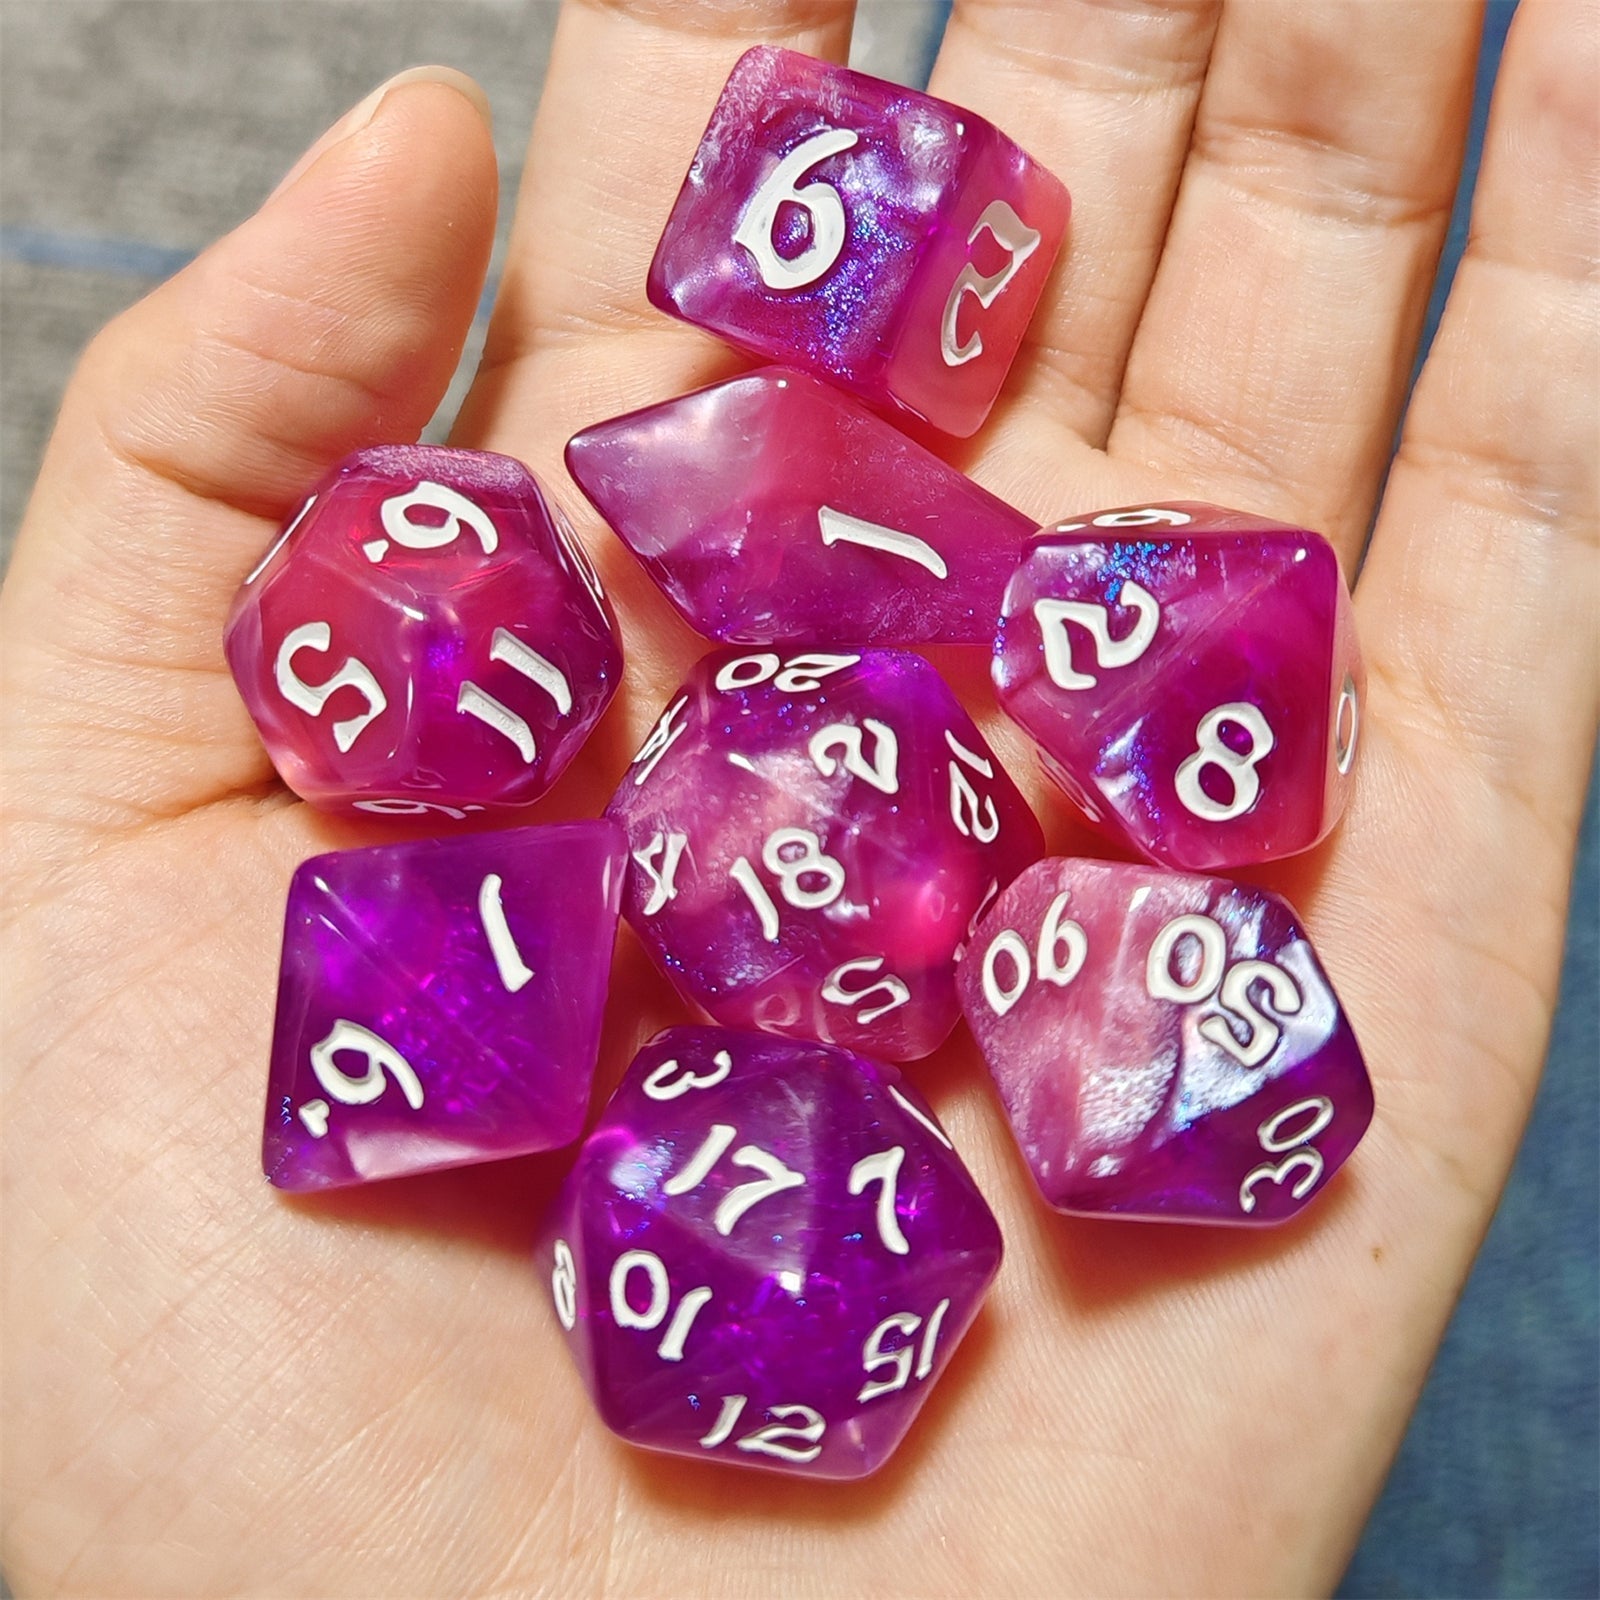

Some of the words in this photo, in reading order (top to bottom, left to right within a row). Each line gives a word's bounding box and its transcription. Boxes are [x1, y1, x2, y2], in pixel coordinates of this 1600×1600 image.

[734, 126, 859, 290] 6
[940, 199, 1042, 367] 2
[818, 505, 948, 579] 1
[275, 621, 387, 753] 5
[715, 653, 861, 692] 20
[1033, 579, 1160, 690] 2
[456, 627, 572, 764] 11
[808, 718, 899, 794] 2
[945, 728, 1003, 844] 12
[1174, 701, 1274, 822] 8
[632, 831, 688, 916] 4
[729, 826, 846, 943] 18
[479, 873, 535, 993] 1
[981, 890, 1089, 1017] 90
[821, 957, 911, 1025] 5
[1146, 913, 1303, 1069] 50
[642, 1049, 732, 1101] 3
[663, 1124, 806, 1236] 17
[848, 1145, 910, 1255] 7
[1238, 1096, 1335, 1213] 30
[609, 1249, 713, 1361] 10
[857, 1298, 950, 1403] 15
[700, 1395, 827, 1463] 12
